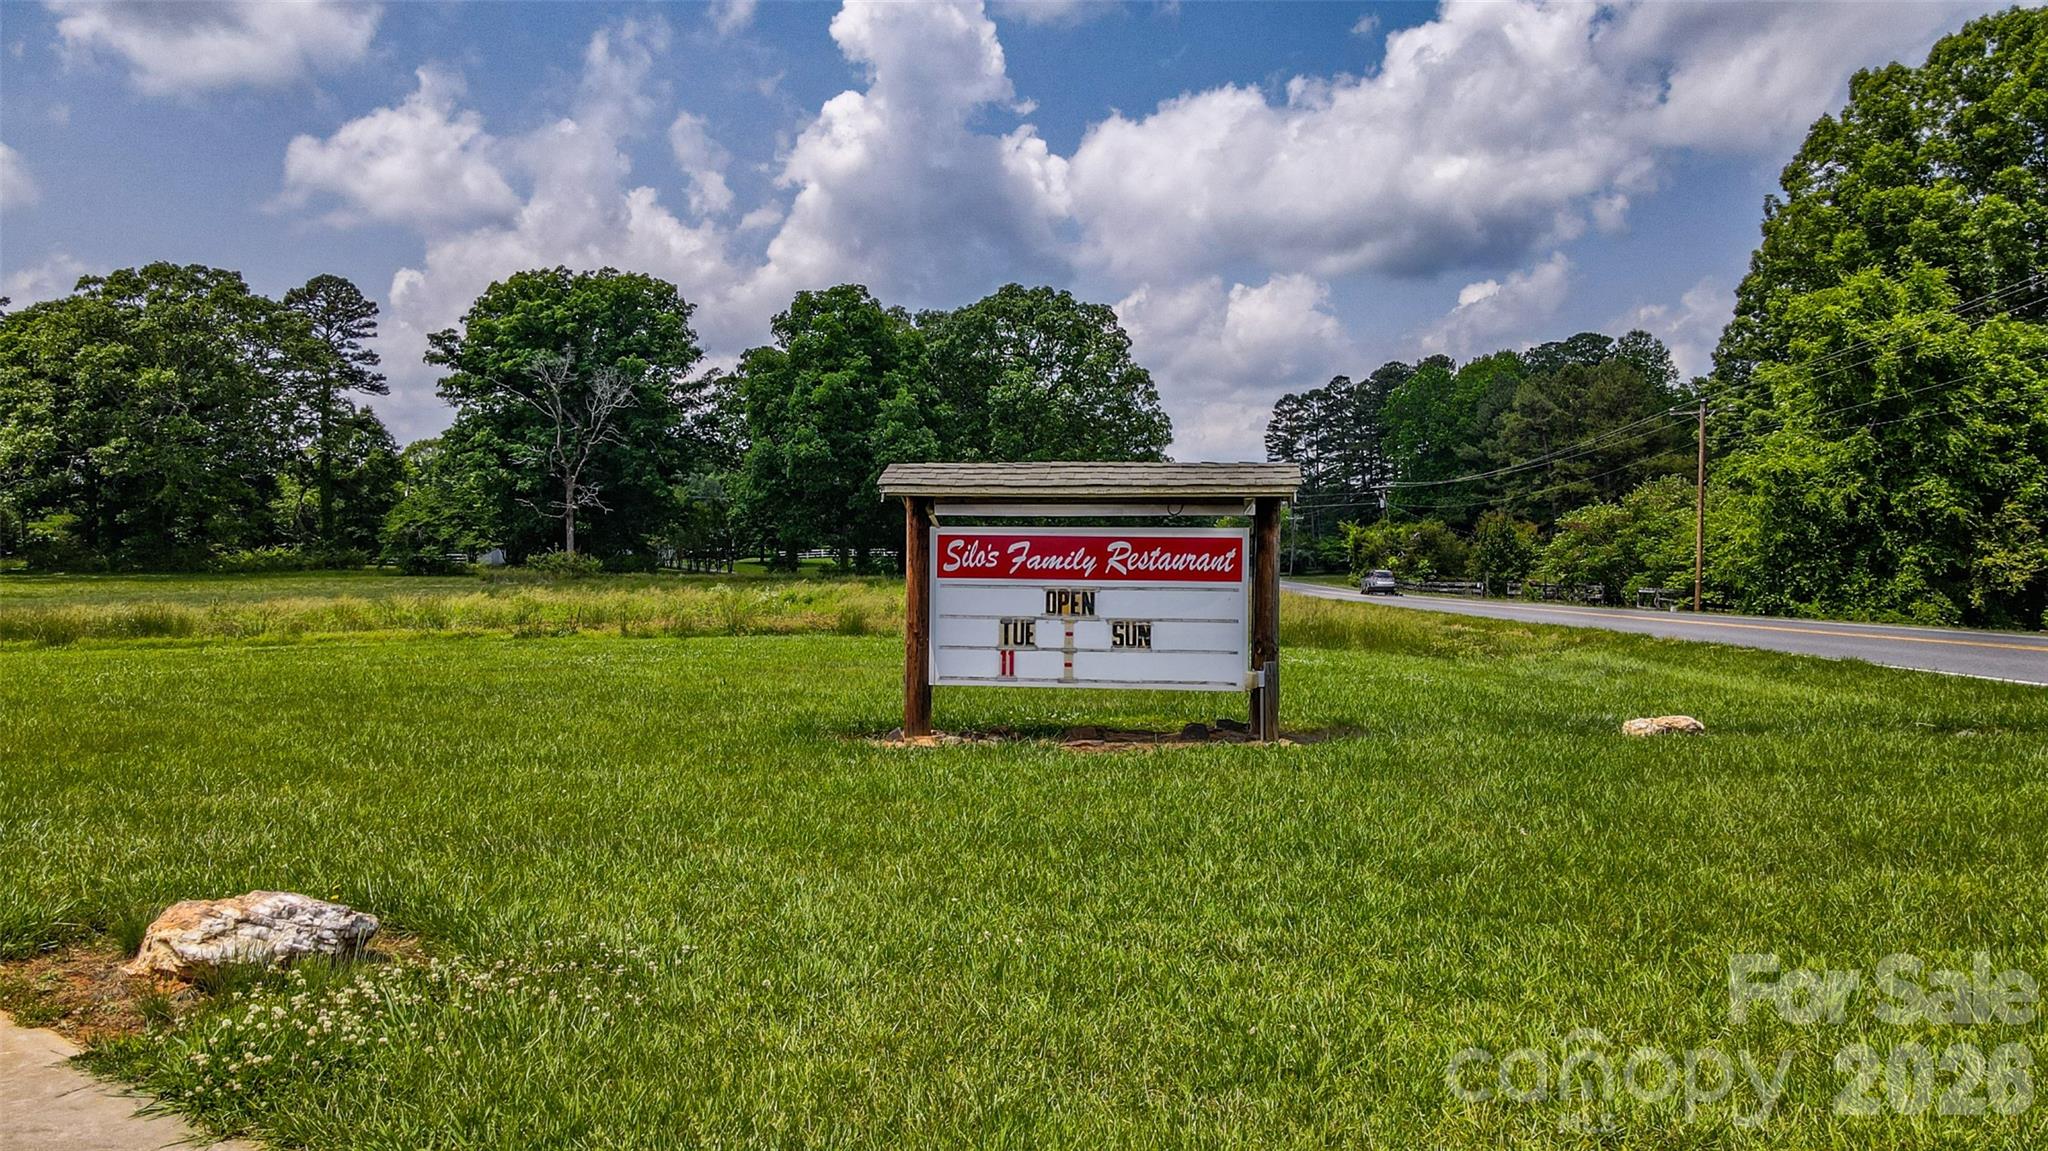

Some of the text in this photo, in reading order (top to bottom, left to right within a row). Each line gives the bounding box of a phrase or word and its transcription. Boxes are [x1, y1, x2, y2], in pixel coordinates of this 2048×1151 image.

[943, 539, 1237, 578] Silo's Family Restaurant
[1045, 589, 1096, 616] OPEN
[1000, 621, 1036, 646] TUE
[1112, 623, 1152, 649] SUN
[1000, 650, 1015, 677] 11
